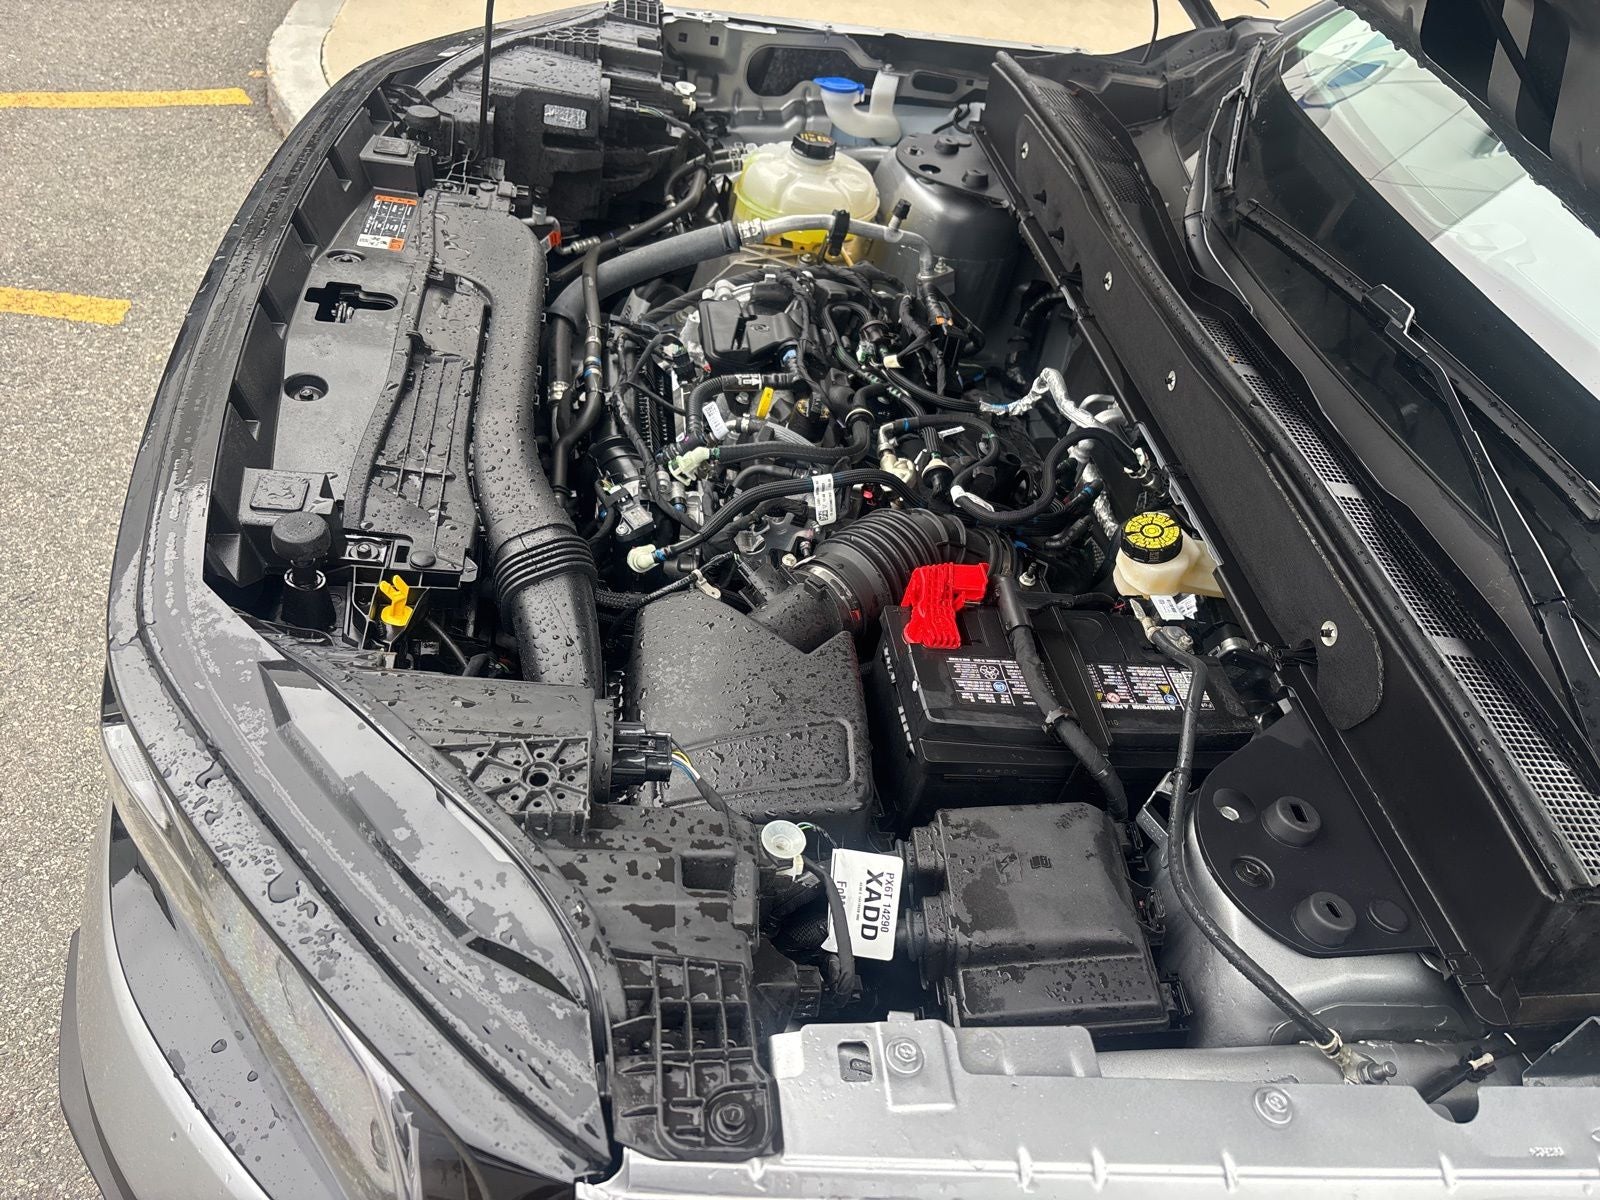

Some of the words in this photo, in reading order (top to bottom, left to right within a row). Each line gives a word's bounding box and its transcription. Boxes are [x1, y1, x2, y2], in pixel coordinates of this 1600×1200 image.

[884, 872, 895, 899] PX6T
[861, 868, 884, 941] XADD
[880, 903, 892, 933] 14290
